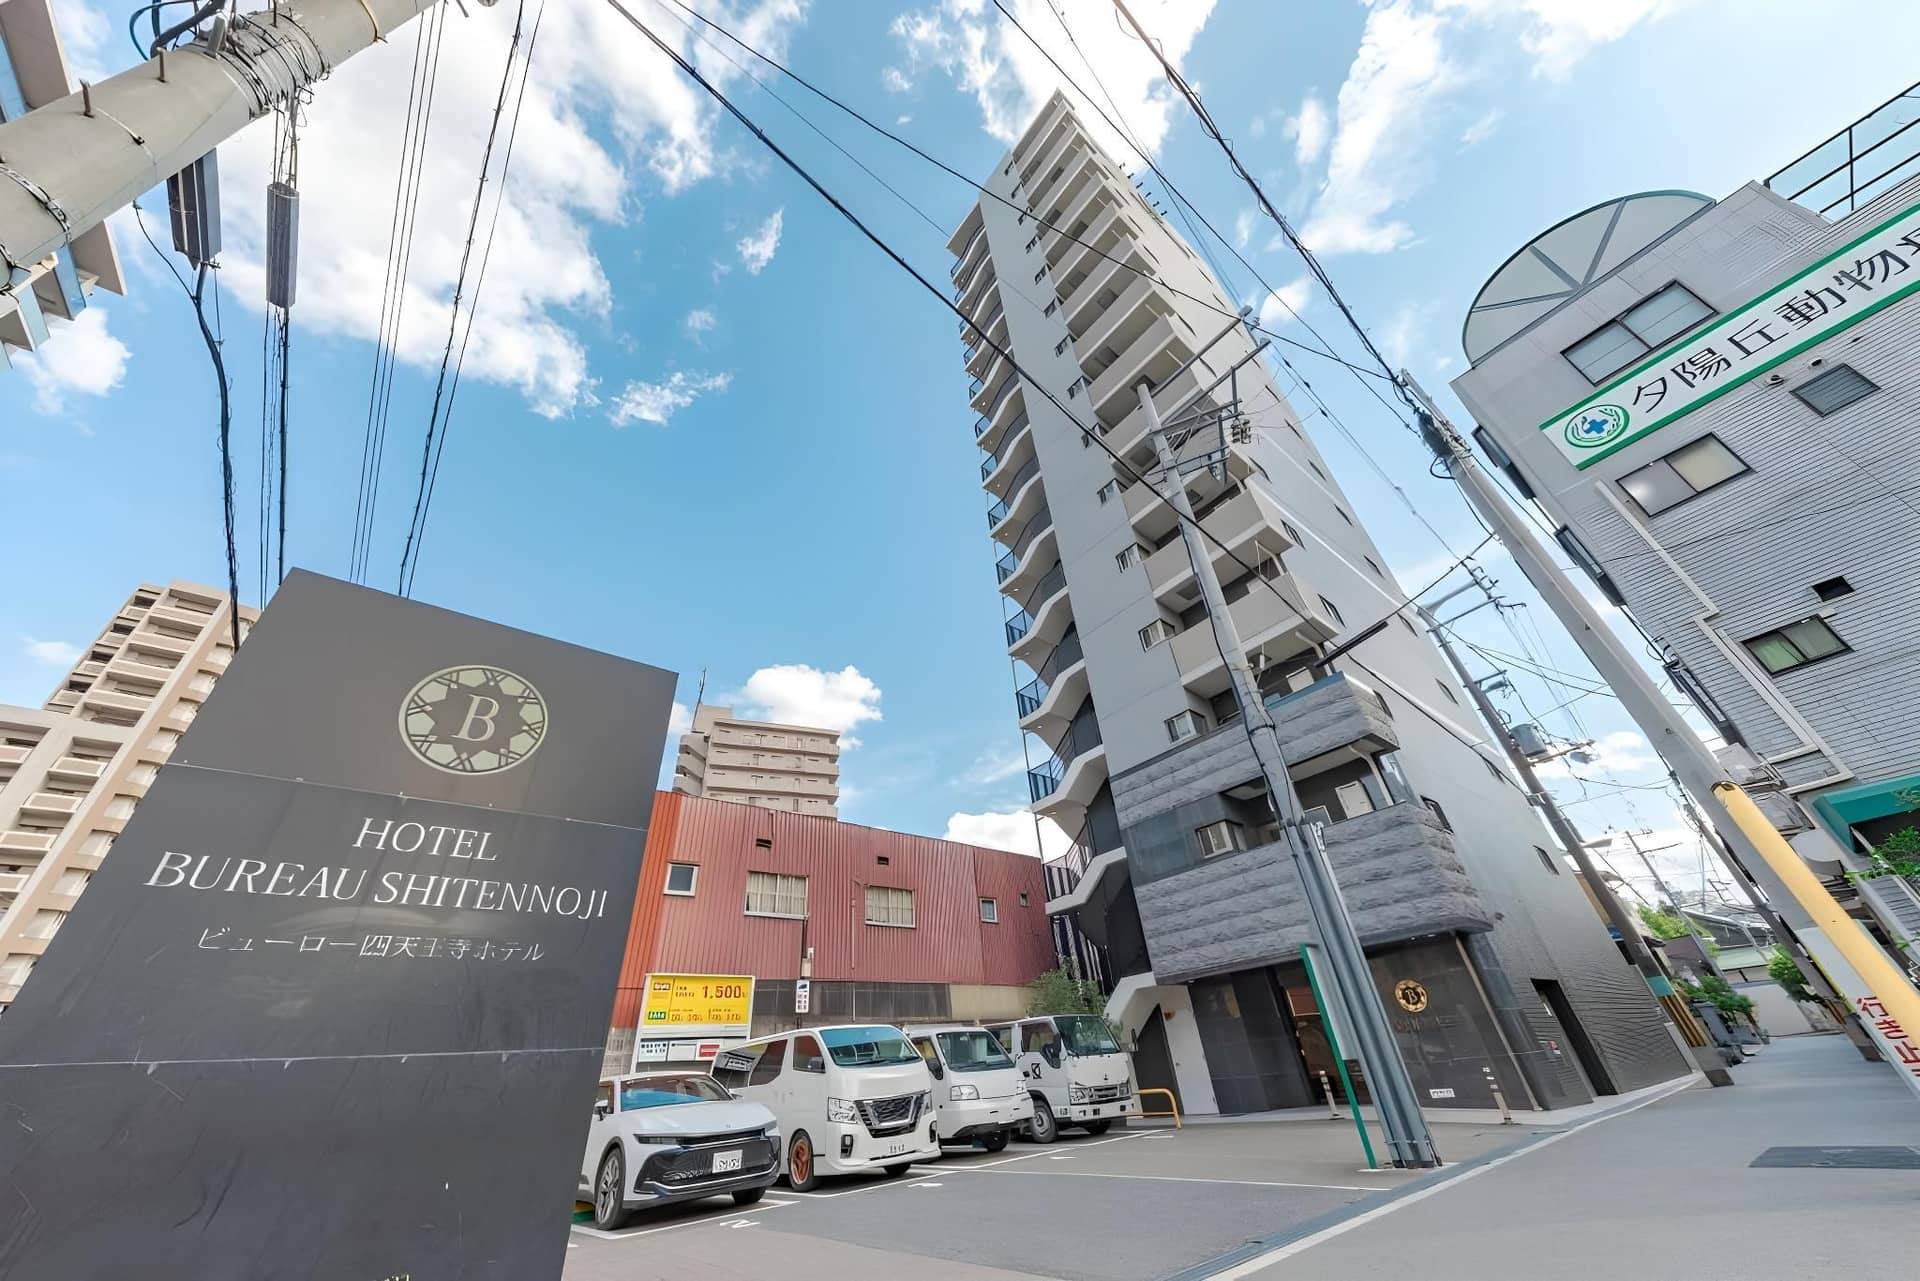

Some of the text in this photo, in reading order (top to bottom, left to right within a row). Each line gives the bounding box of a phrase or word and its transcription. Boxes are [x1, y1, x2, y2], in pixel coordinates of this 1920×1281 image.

[450, 694, 501, 744] B
[351, 816, 498, 863] HOTEL
[143, 851, 609, 919] BUREAU SHITENNOJI
[198, 927, 545, 961] ビューロー四天王寺ホテル
